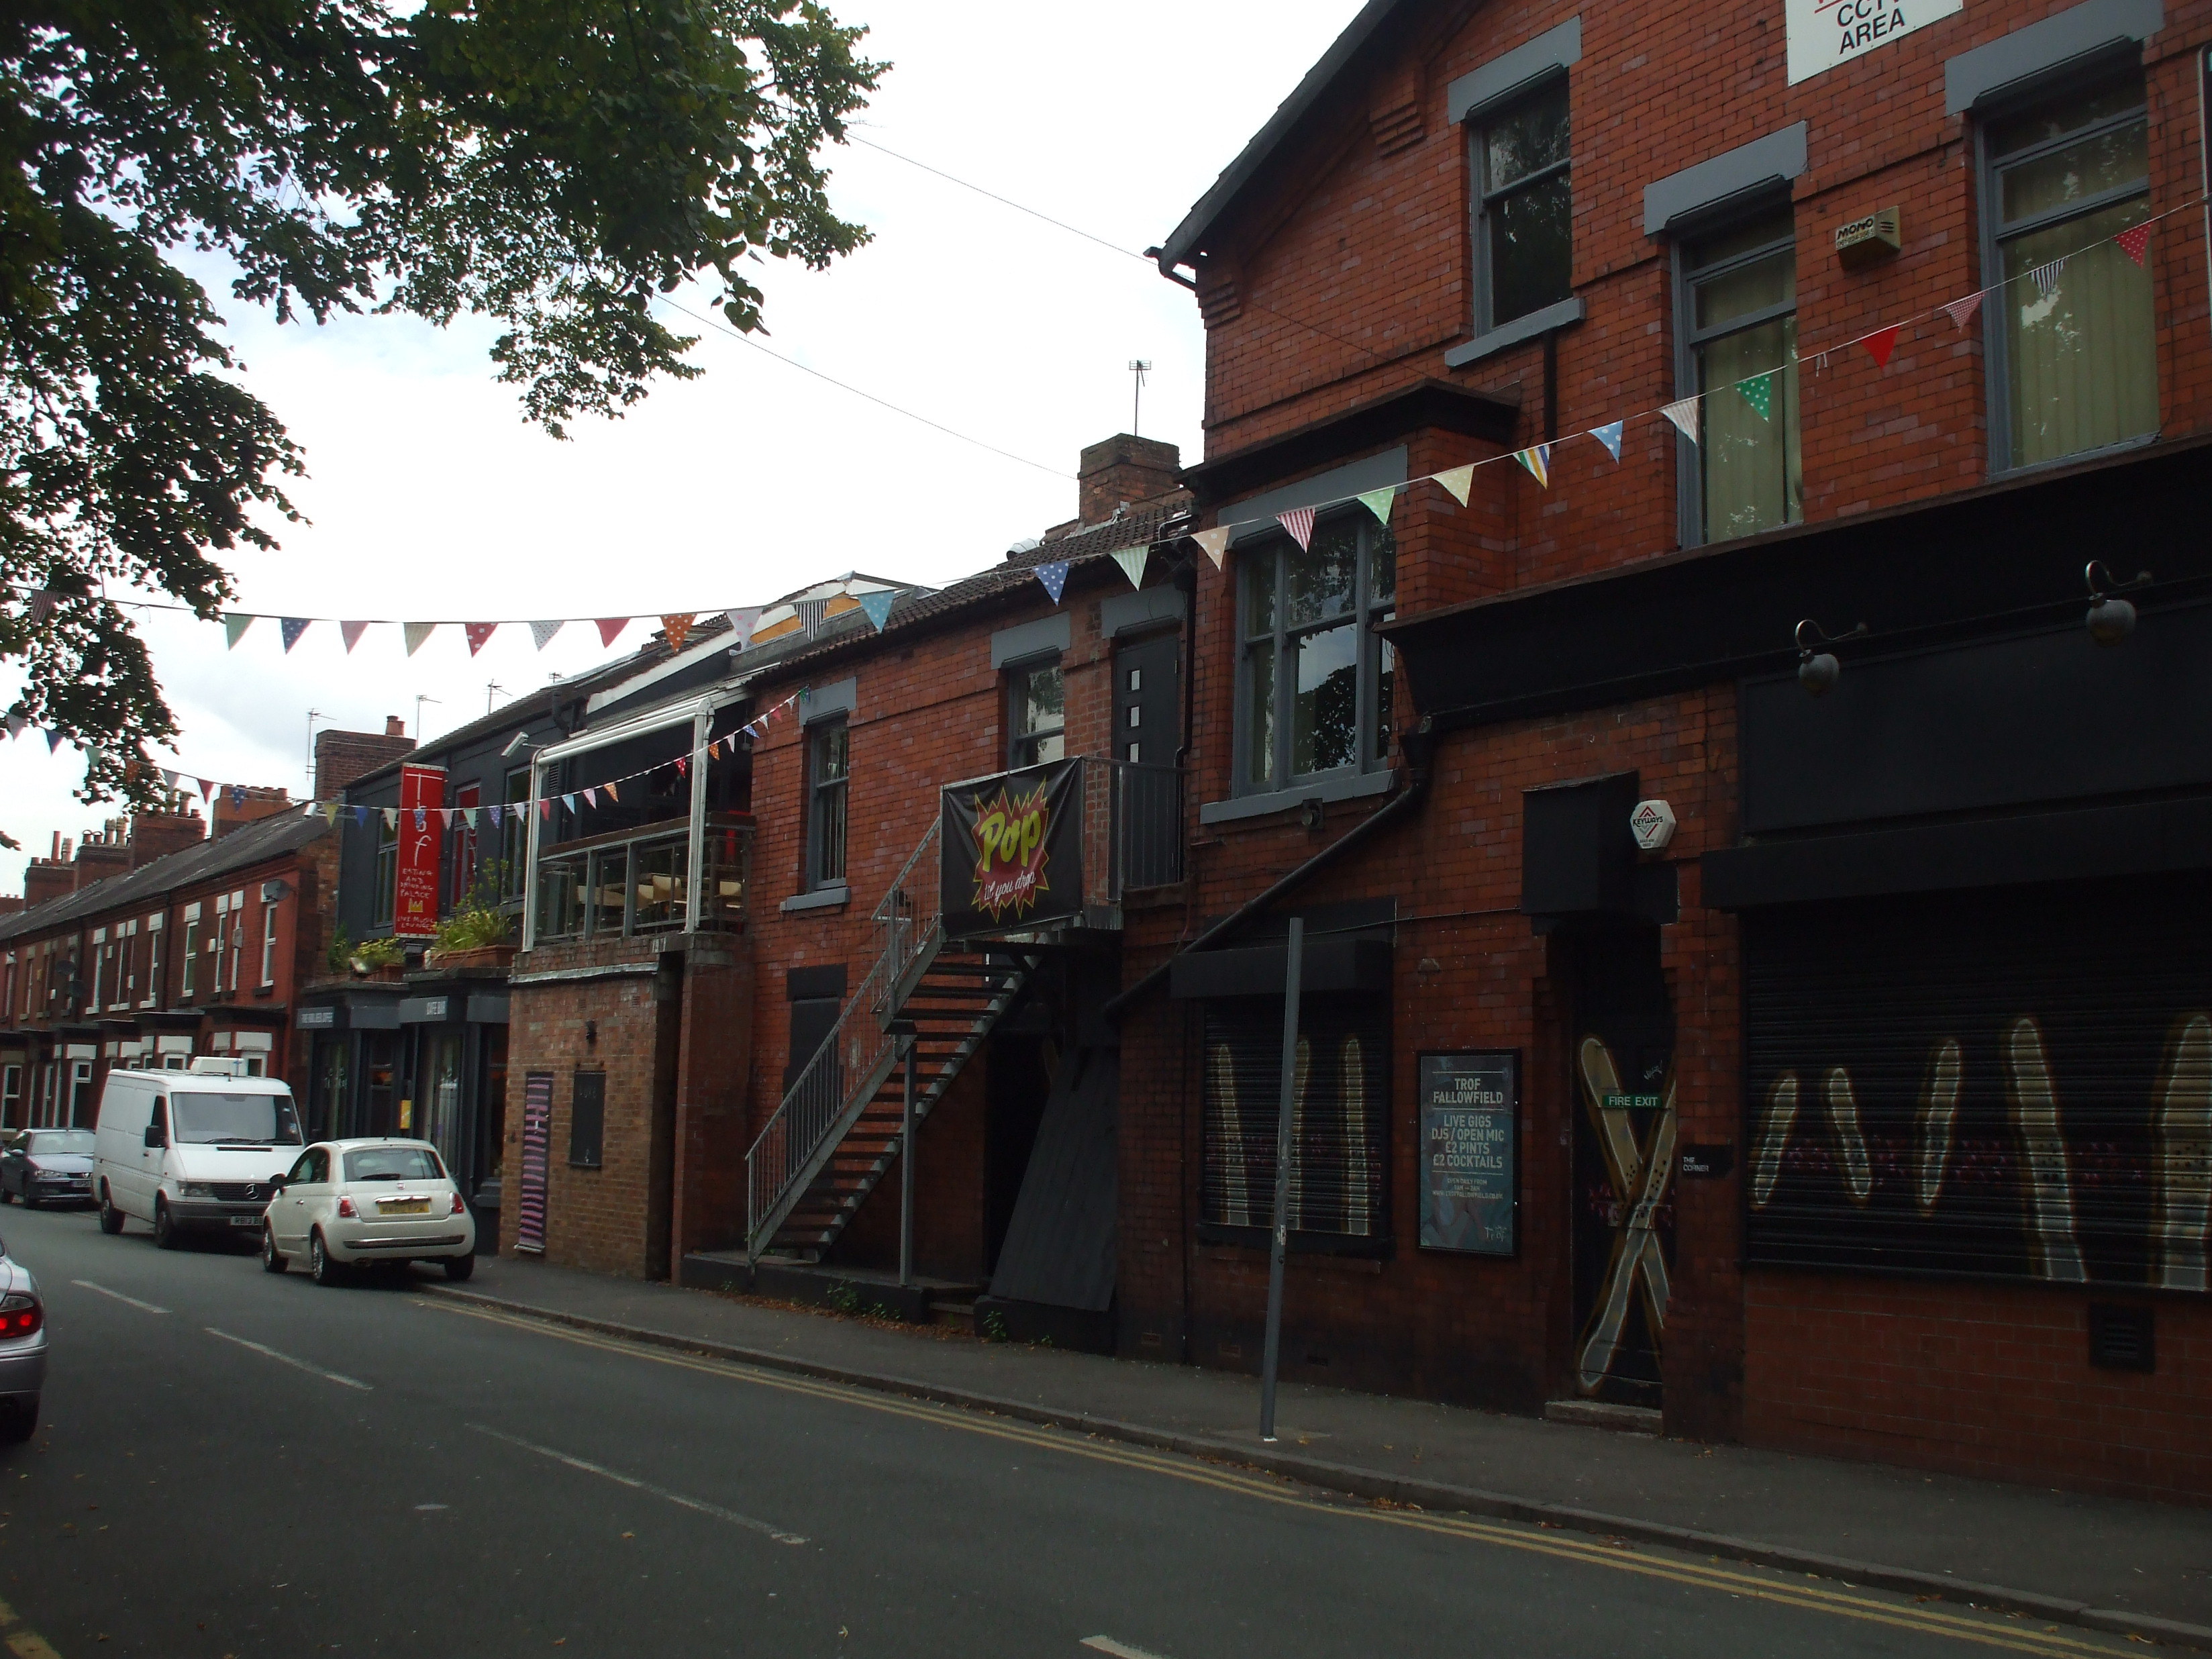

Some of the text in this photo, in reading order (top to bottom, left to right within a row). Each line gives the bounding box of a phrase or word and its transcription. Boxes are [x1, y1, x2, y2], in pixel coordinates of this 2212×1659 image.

[1837, 0, 1899, 27] CCT
[1839, 8, 1905, 55] AREA
[1633, 816, 1664, 827] KEYWAYS
[405, 876, 424, 885] AND
[400, 889, 430, 899] PALACE
[994, 881, 1014, 907] you
[1014, 870, 1037, 891] drop
[1454, 1078, 1481, 1091] TROF
[1433, 1091, 1503, 1104] FALLOWFIELD
[1609, 1096, 1658, 1106] FIRE EXIT
[1444, 1115, 1492, 1127] LIVE GIGS
[1457, 1129, 1484, 1142] OPEN
[1486, 1129, 1505, 1142] MIC
[1446, 1141, 1490, 1154] £2 PINTS
[1433, 1154, 1503, 1168] £2 COCKTAILS
